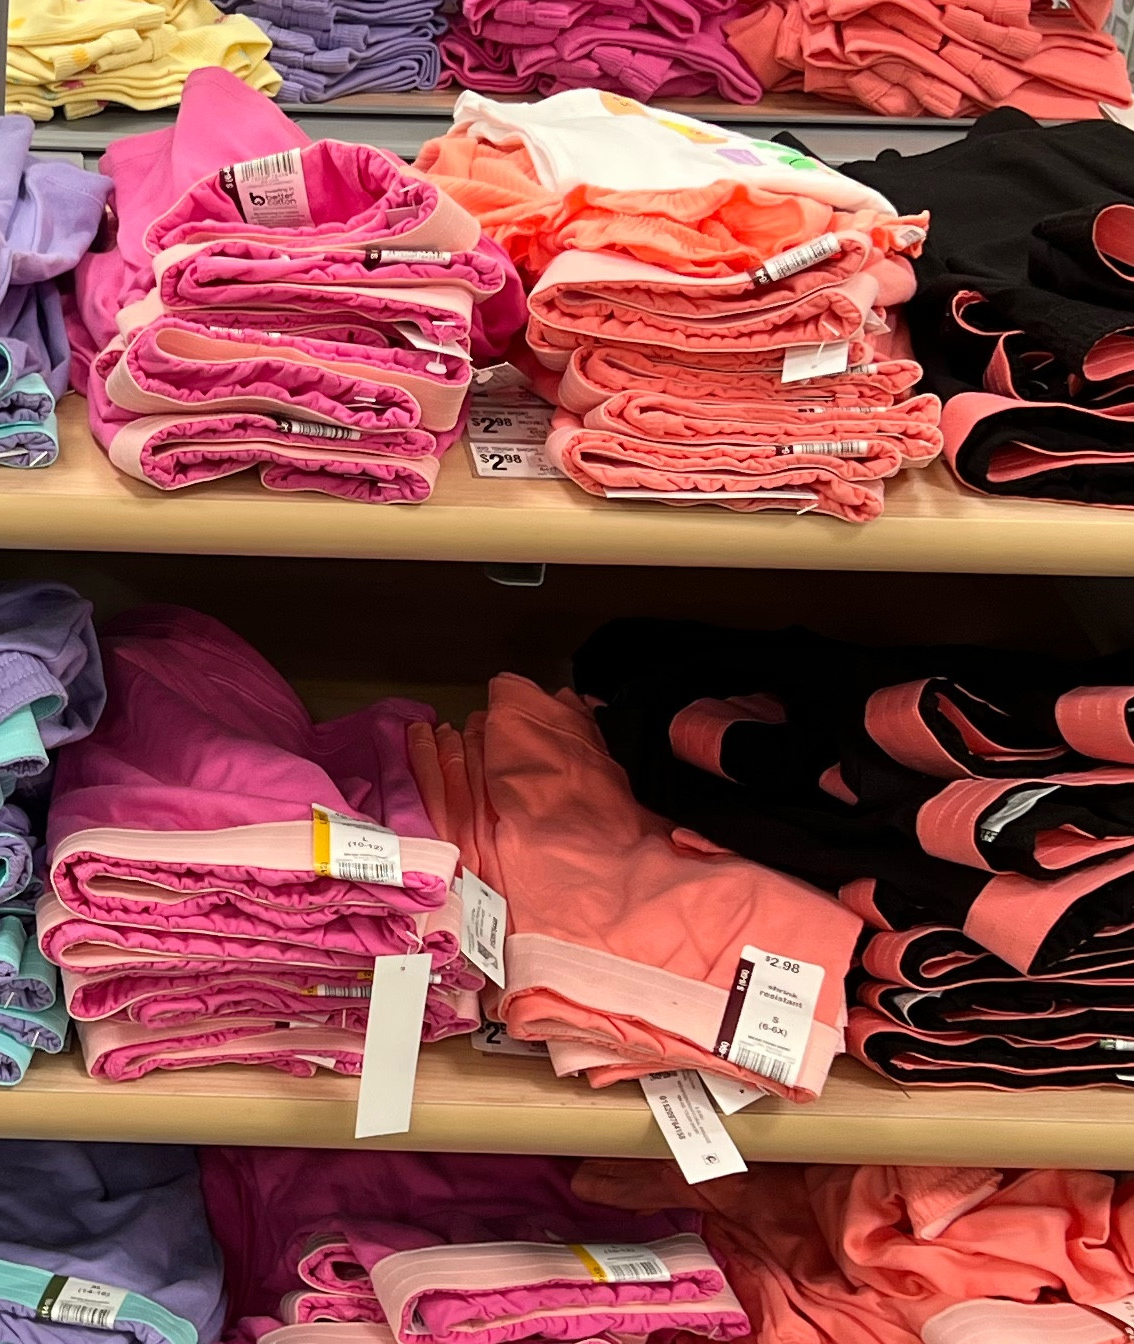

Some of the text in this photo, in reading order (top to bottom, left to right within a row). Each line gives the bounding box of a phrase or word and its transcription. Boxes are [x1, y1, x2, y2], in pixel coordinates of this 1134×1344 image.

[765, 955, 801, 974] $2.98
[759, 990, 803, 1009] resistant
[772, 1016, 780, 1024] S
[758, 1022, 788, 1038] (6-6X)
